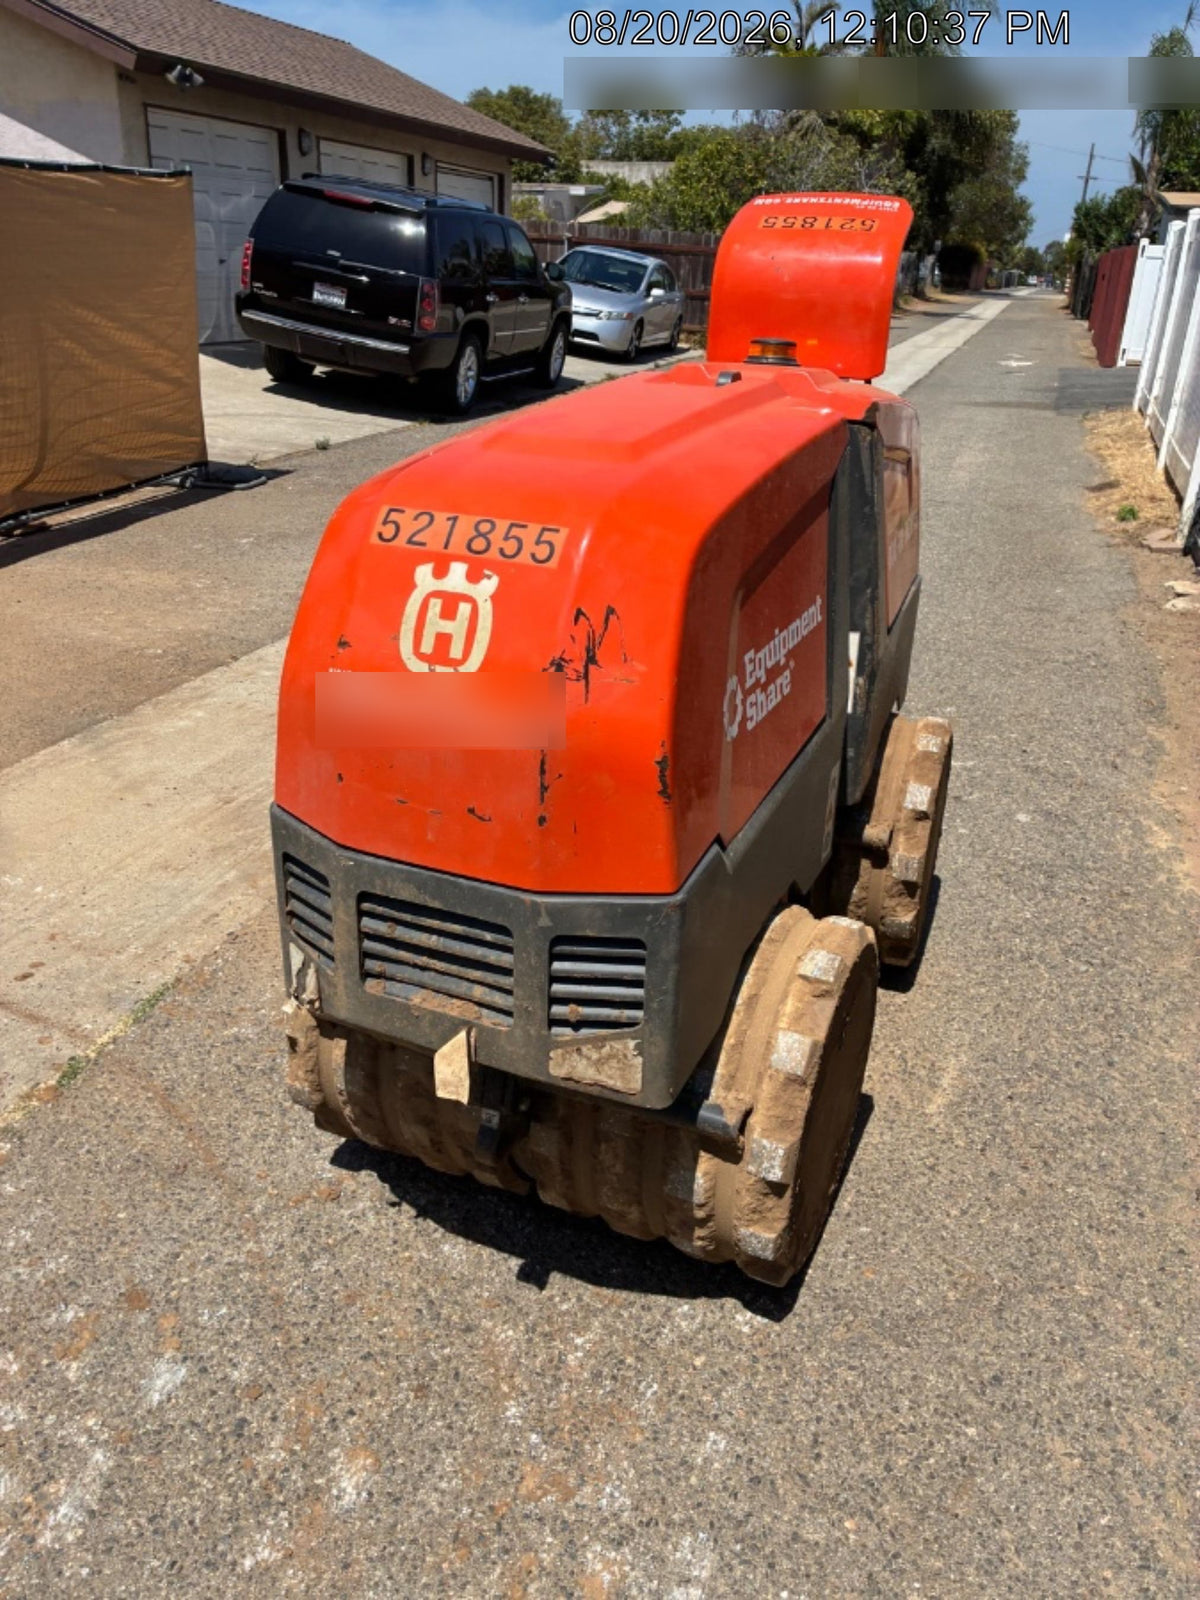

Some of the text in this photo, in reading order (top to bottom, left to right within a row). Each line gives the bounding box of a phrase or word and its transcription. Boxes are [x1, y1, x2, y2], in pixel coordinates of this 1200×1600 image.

[762, 216, 876, 232] 521855
[377, 507, 561, 565] 521855
[743, 595, 823, 690] Equipment
